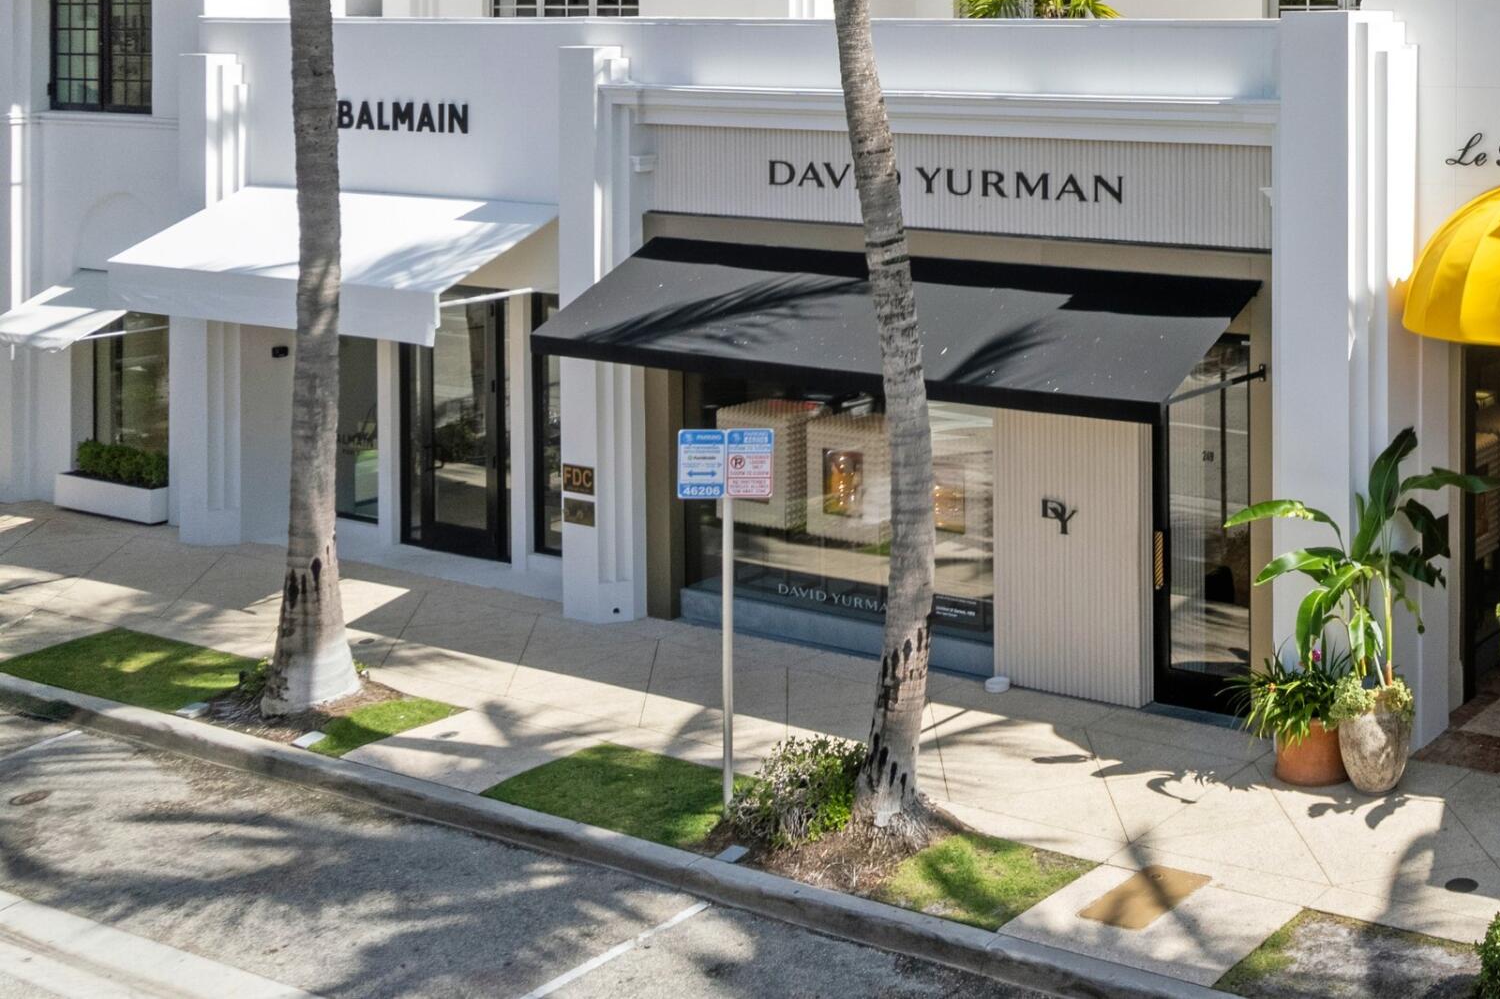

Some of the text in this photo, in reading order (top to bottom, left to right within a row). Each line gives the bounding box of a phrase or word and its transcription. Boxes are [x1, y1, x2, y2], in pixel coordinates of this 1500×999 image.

[338, 100, 468, 134] BALMAIN
[1445, 132, 1487, 166] Le
[768, 160, 1124, 205] DAV YURMAN
[564, 466, 593, 488] FDC
[778, 584, 887, 612] DAVID YURMA
